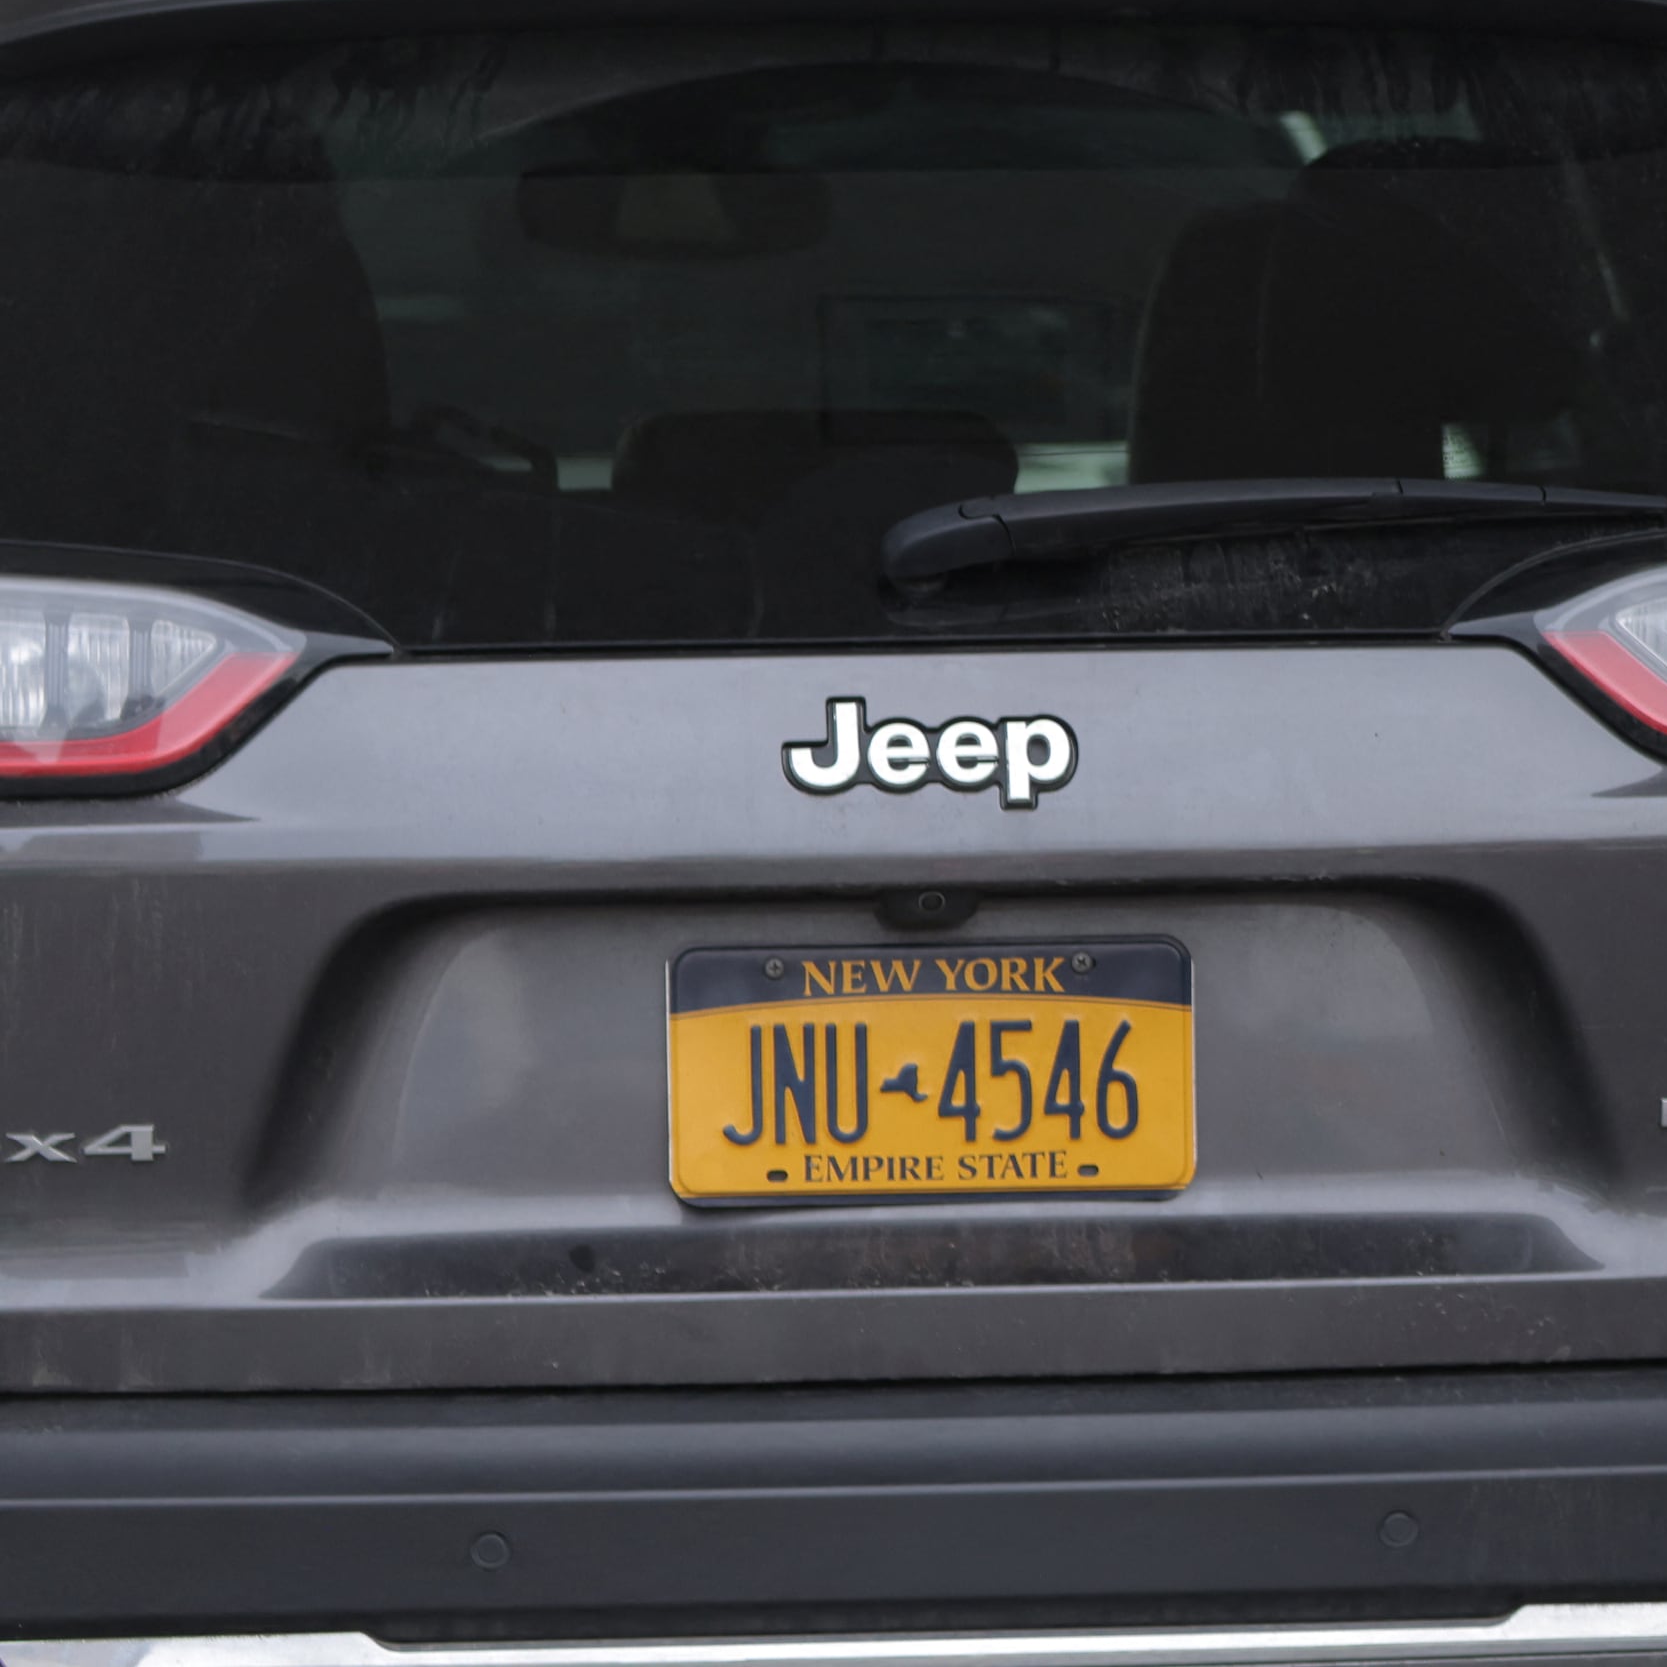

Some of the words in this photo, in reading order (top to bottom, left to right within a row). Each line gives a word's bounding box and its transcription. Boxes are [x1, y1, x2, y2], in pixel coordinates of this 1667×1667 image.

[785, 699, 1074, 805] Jeep
[802, 958, 920, 997] NEW
[937, 956, 1066, 995] YORK
[722, 1022, 868, 1145] JNU
[938, 1019, 1139, 1143] 4546
[5, 1124, 167, 1163] x4
[803, 1152, 944, 1183] EMPIRE
[957, 1150, 1068, 1181] STATE
